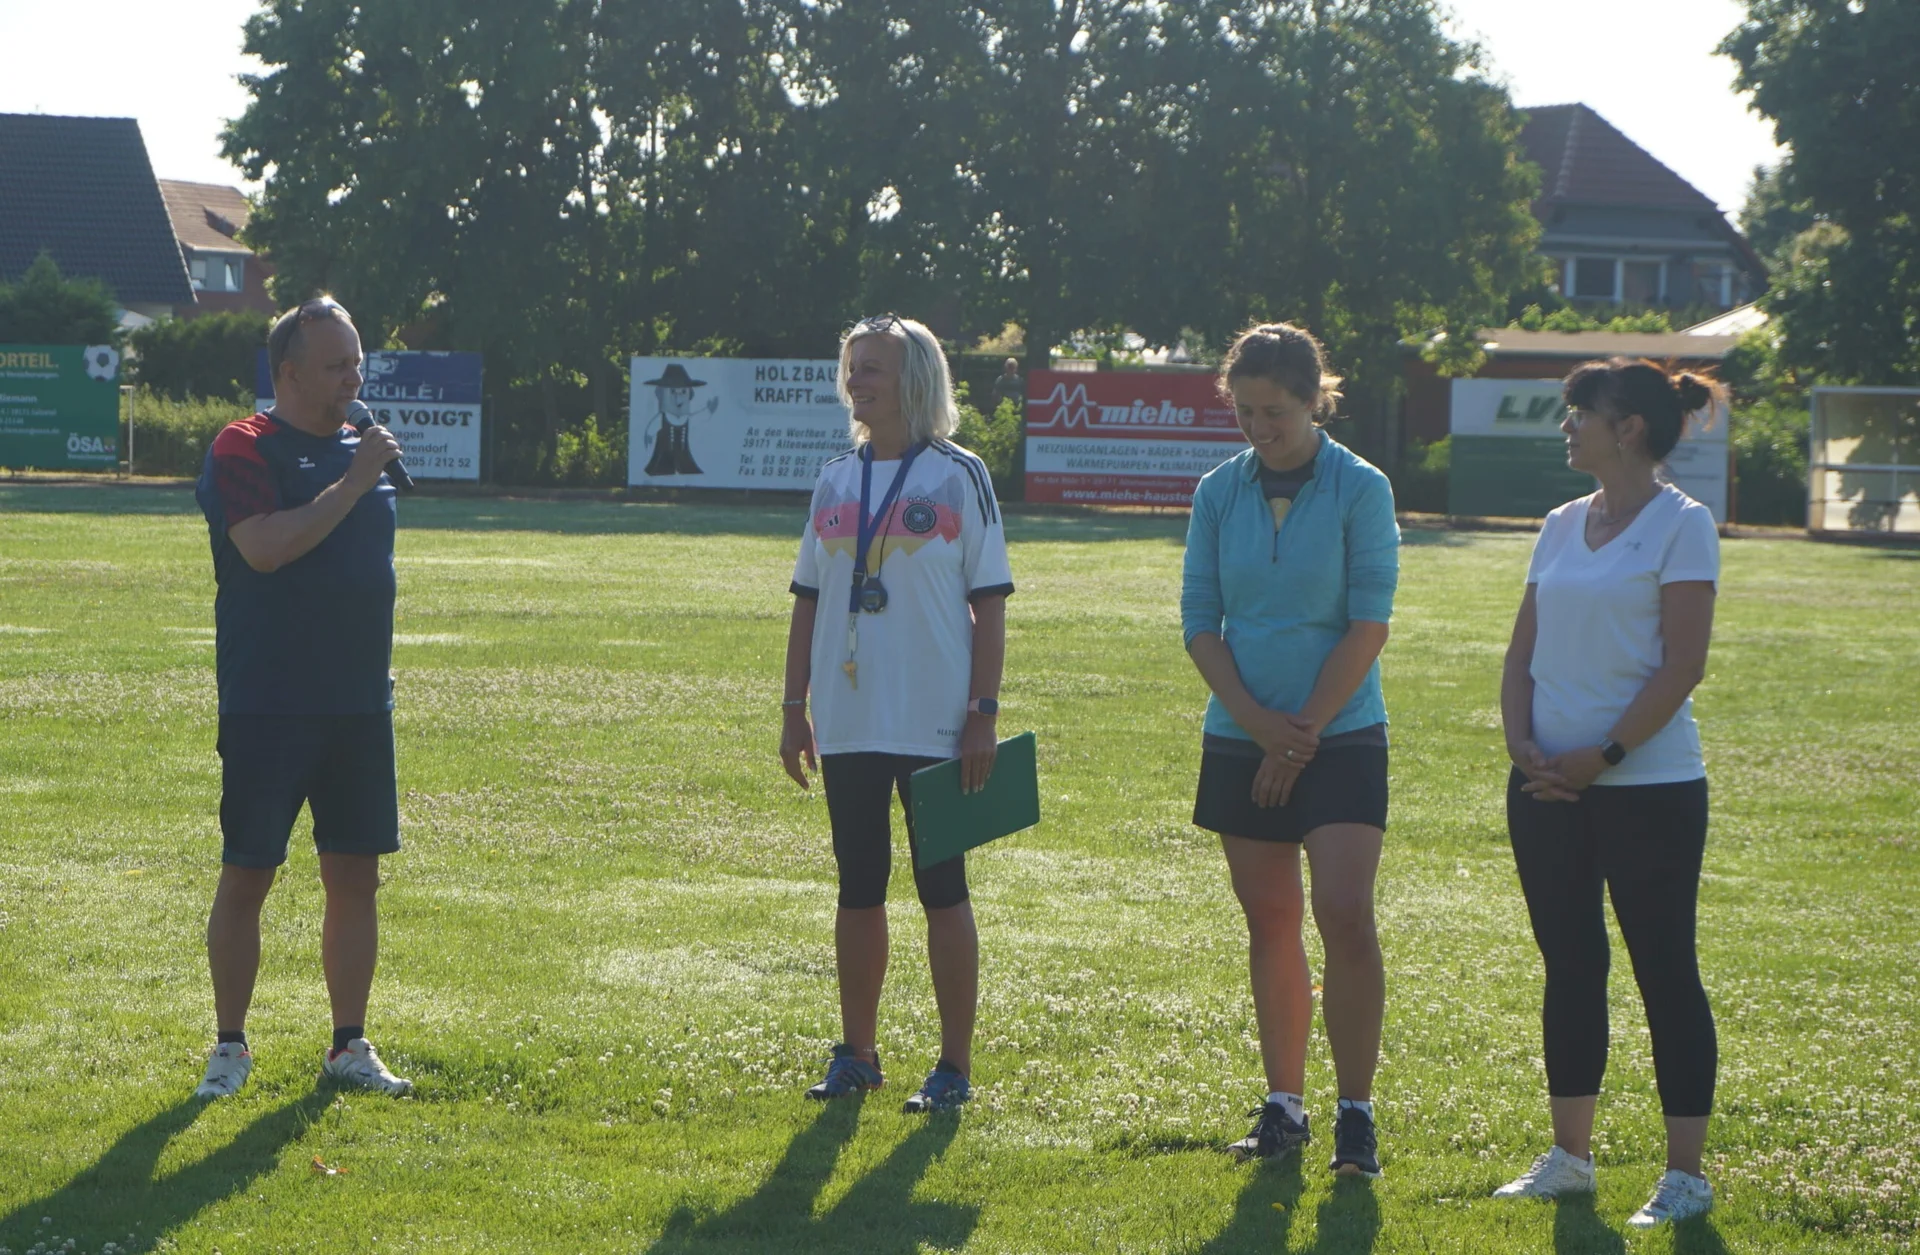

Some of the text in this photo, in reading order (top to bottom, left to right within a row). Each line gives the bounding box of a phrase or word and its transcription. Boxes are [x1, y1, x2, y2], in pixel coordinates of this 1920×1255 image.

[755, 366, 838, 382] HOLZBAU
[754, 387, 813, 404] KRAFFT
[398, 408, 473, 427] VOIGT
[1098, 399, 1196, 425] miehe
[765, 427, 782, 438] den
[67, 432, 104, 453] ÖSA
[743, 438, 771, 448] 39171
[1036, 443, 1139, 456] HEIZUNGSANLAGEN
[1147, 444, 1187, 457] BÄDER
[434, 457, 455, 467] 212
[458, 458, 471, 468] 52
[1066, 458, 1151, 470] WÄRMEPUMPEN
